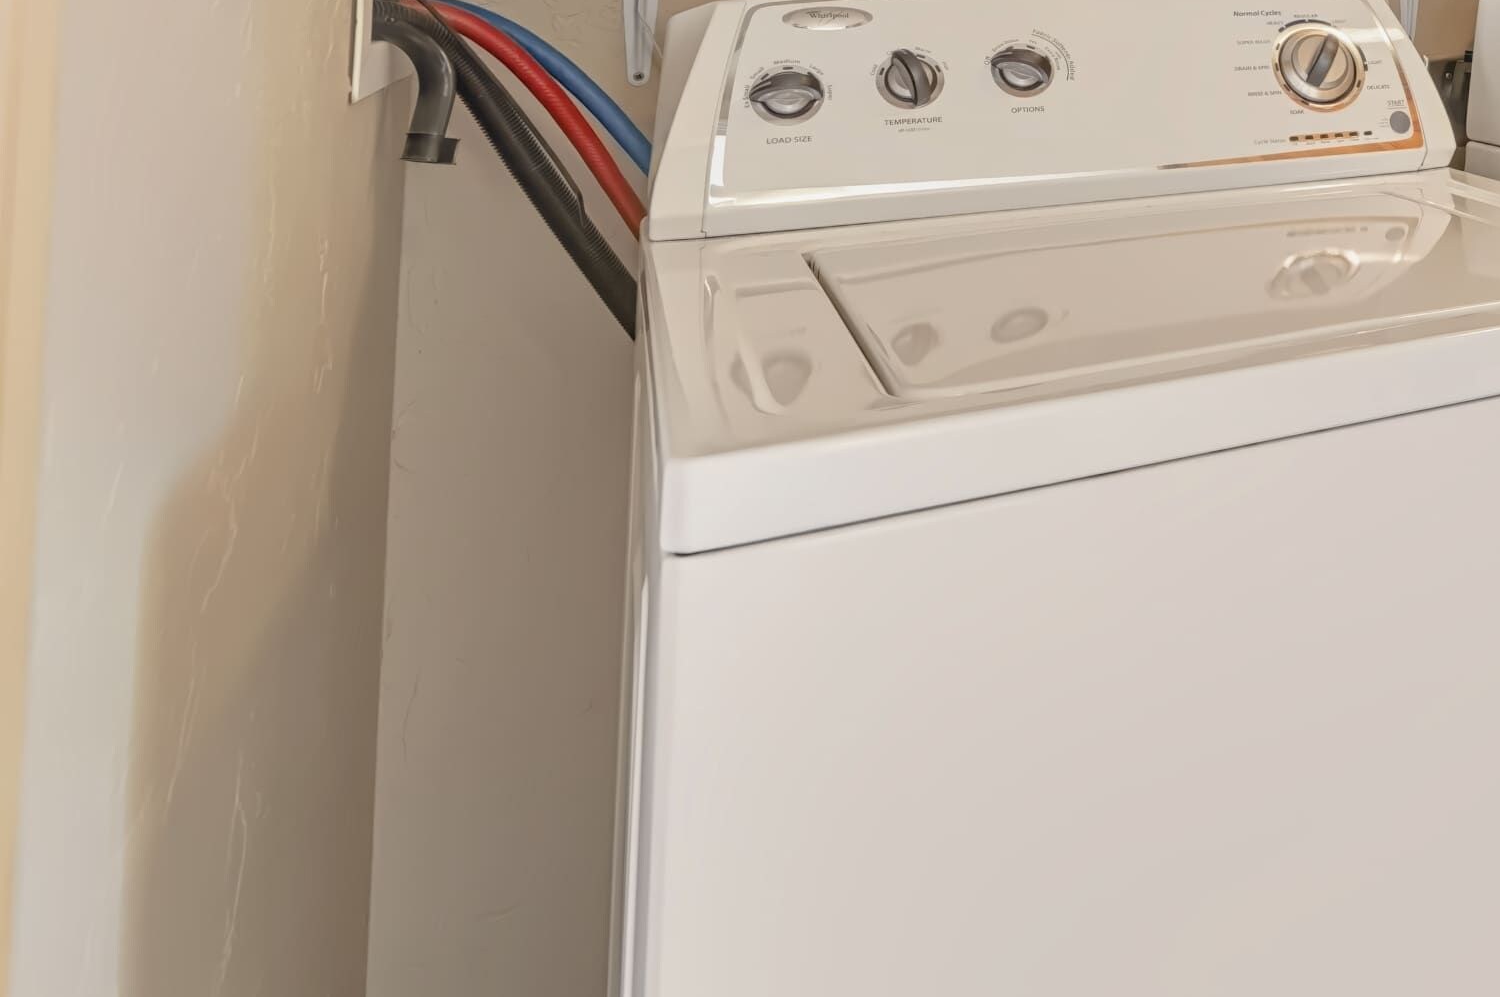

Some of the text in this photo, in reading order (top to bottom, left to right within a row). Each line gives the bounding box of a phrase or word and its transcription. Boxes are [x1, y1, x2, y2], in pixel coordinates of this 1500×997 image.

[809, 11, 849, 19] Whirlpool
[1011, 106, 1045, 114] OPTIONS
[884, 116, 943, 126] TEMPERATURE
[766, 135, 813, 144] LOAD SIZE
